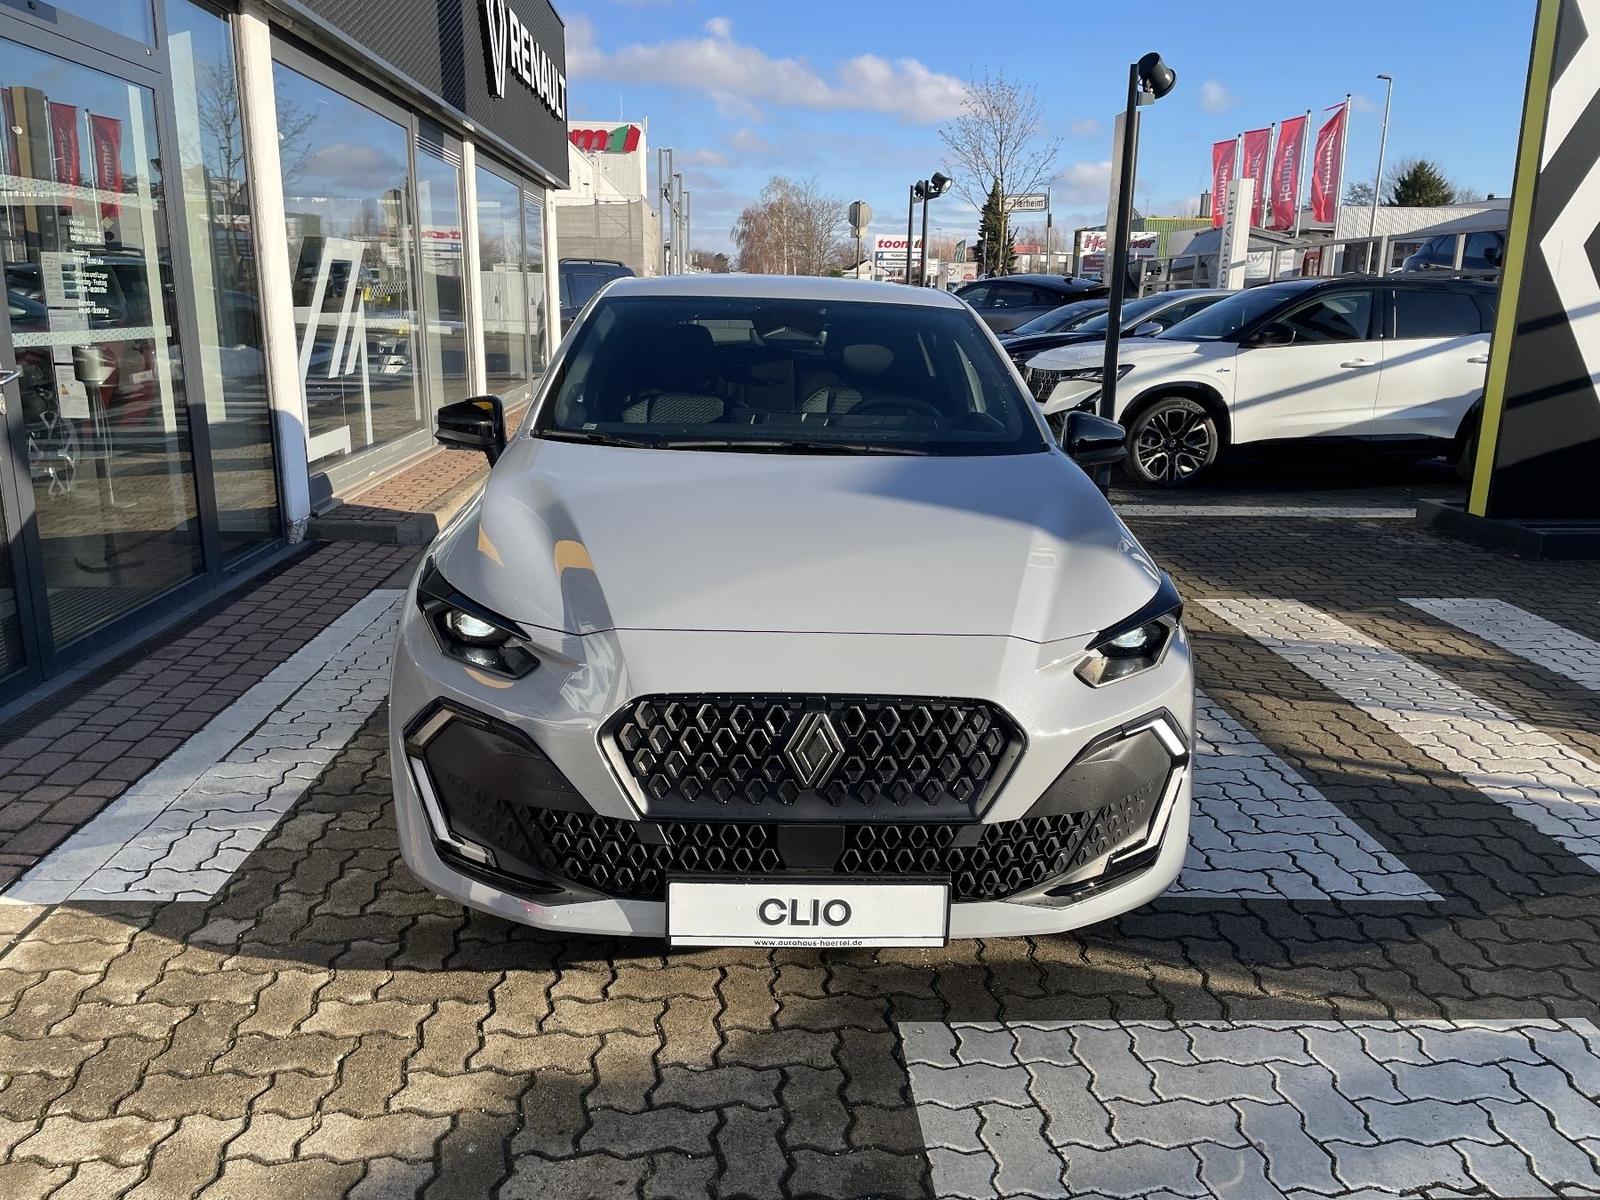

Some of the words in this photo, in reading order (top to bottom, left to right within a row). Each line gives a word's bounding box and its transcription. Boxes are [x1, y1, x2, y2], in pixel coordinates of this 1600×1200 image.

[508, 7, 565, 121] RENAULT
[1013, 199, 1044, 208] Tierheim
[758, 898, 852, 926] CLIO
